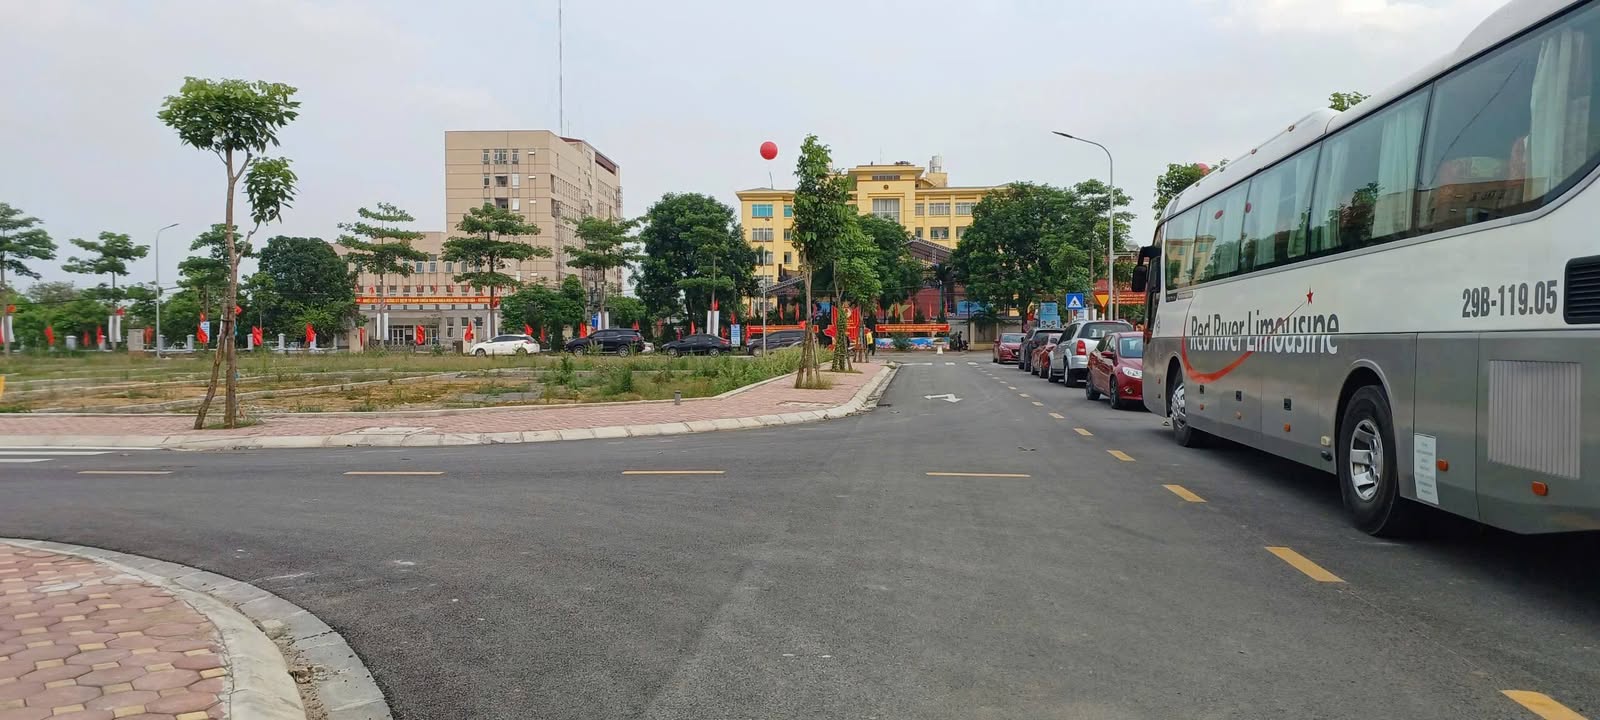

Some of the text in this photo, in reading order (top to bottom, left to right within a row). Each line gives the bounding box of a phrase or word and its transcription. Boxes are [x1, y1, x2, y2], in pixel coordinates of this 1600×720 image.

[1462, 280, 1558, 317] 29B-119.05
[1190, 309, 1339, 354] Red River Limousine
